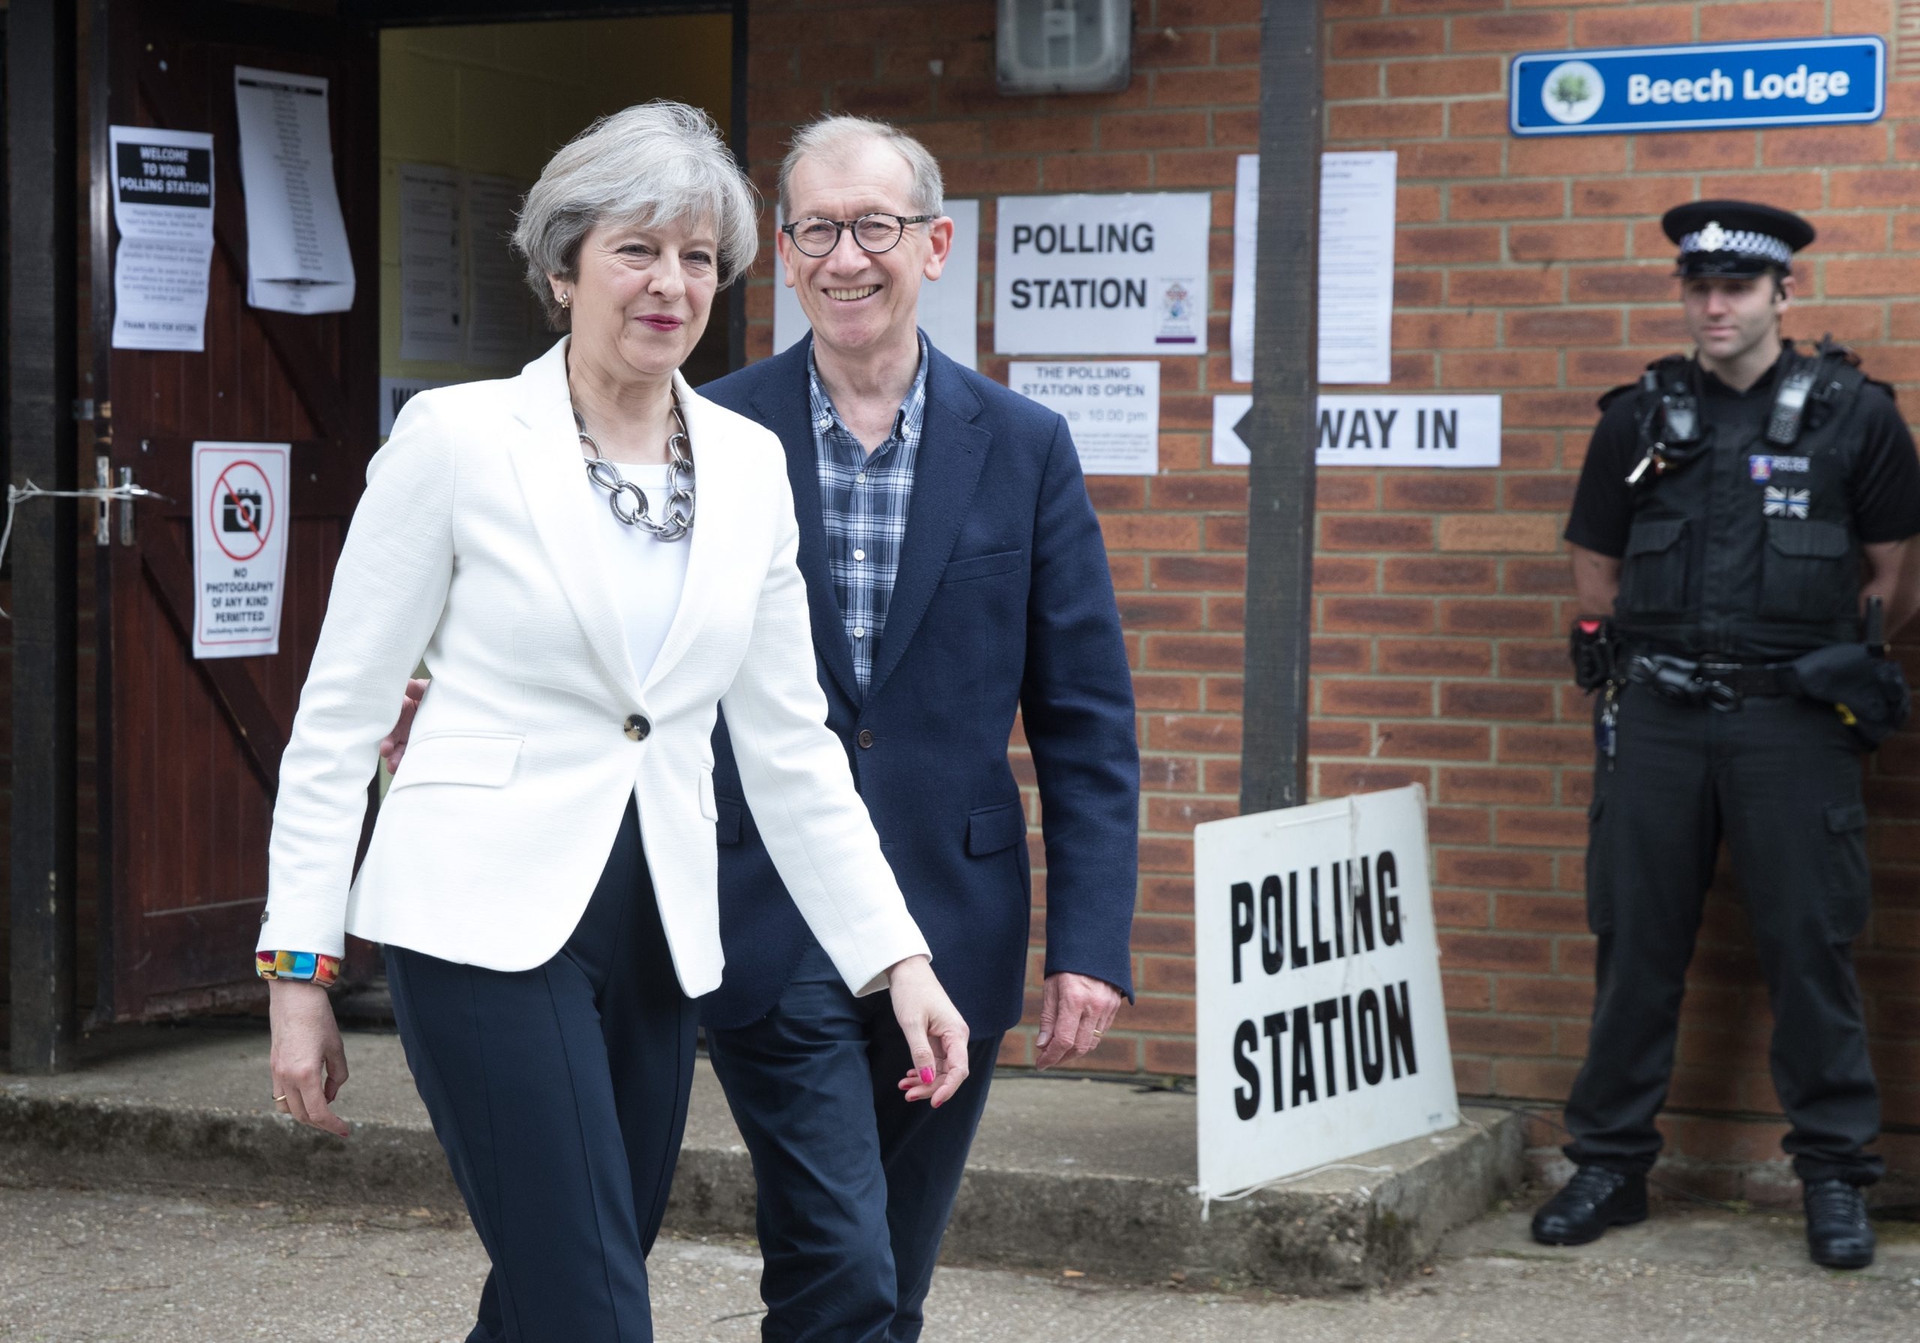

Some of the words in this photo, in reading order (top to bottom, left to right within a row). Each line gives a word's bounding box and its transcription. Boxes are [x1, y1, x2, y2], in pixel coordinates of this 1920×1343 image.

[1627, 68, 1733, 105] Beech
[1743, 64, 1850, 104] Lodge
[140, 146, 189, 163] WELCOME
[142, 162, 158, 176] TO
[159, 164, 187, 179] YOUR
[119, 177, 164, 193] POLLING
[165, 180, 210, 195] STATION
[1012, 223, 1155, 254] POLLING
[1010, 278, 1148, 309] STATION
[123, 320, 145, 331] THANK
[148, 322, 160, 332] YOU
[162, 323, 174, 332] FOR
[175, 324, 198, 334] VOTING
[1036, 366, 1063, 378] THE
[1068, 366, 1131, 378] POLLING
[1022, 383, 1083, 396] STATION
[1087, 384, 1101, 396] IS
[1104, 384, 1146, 396] OPEN
[1067, 410, 1081, 420] to
[1127, 412, 1148, 424] pm
[1316, 409, 1398, 449] WAY
[1417, 409, 1458, 449] IN
[233, 567, 248, 578] NO
[206, 581, 274, 593] PHOTOGRAPHY
[211, 597, 222, 608] OF
[225, 597, 243, 607] ANY
[245, 595, 269, 607] KIND
[215, 610, 265, 622] PERMITTED
[1230, 850, 1404, 984] POLLING
[1233, 980, 1418, 1121] STATION
